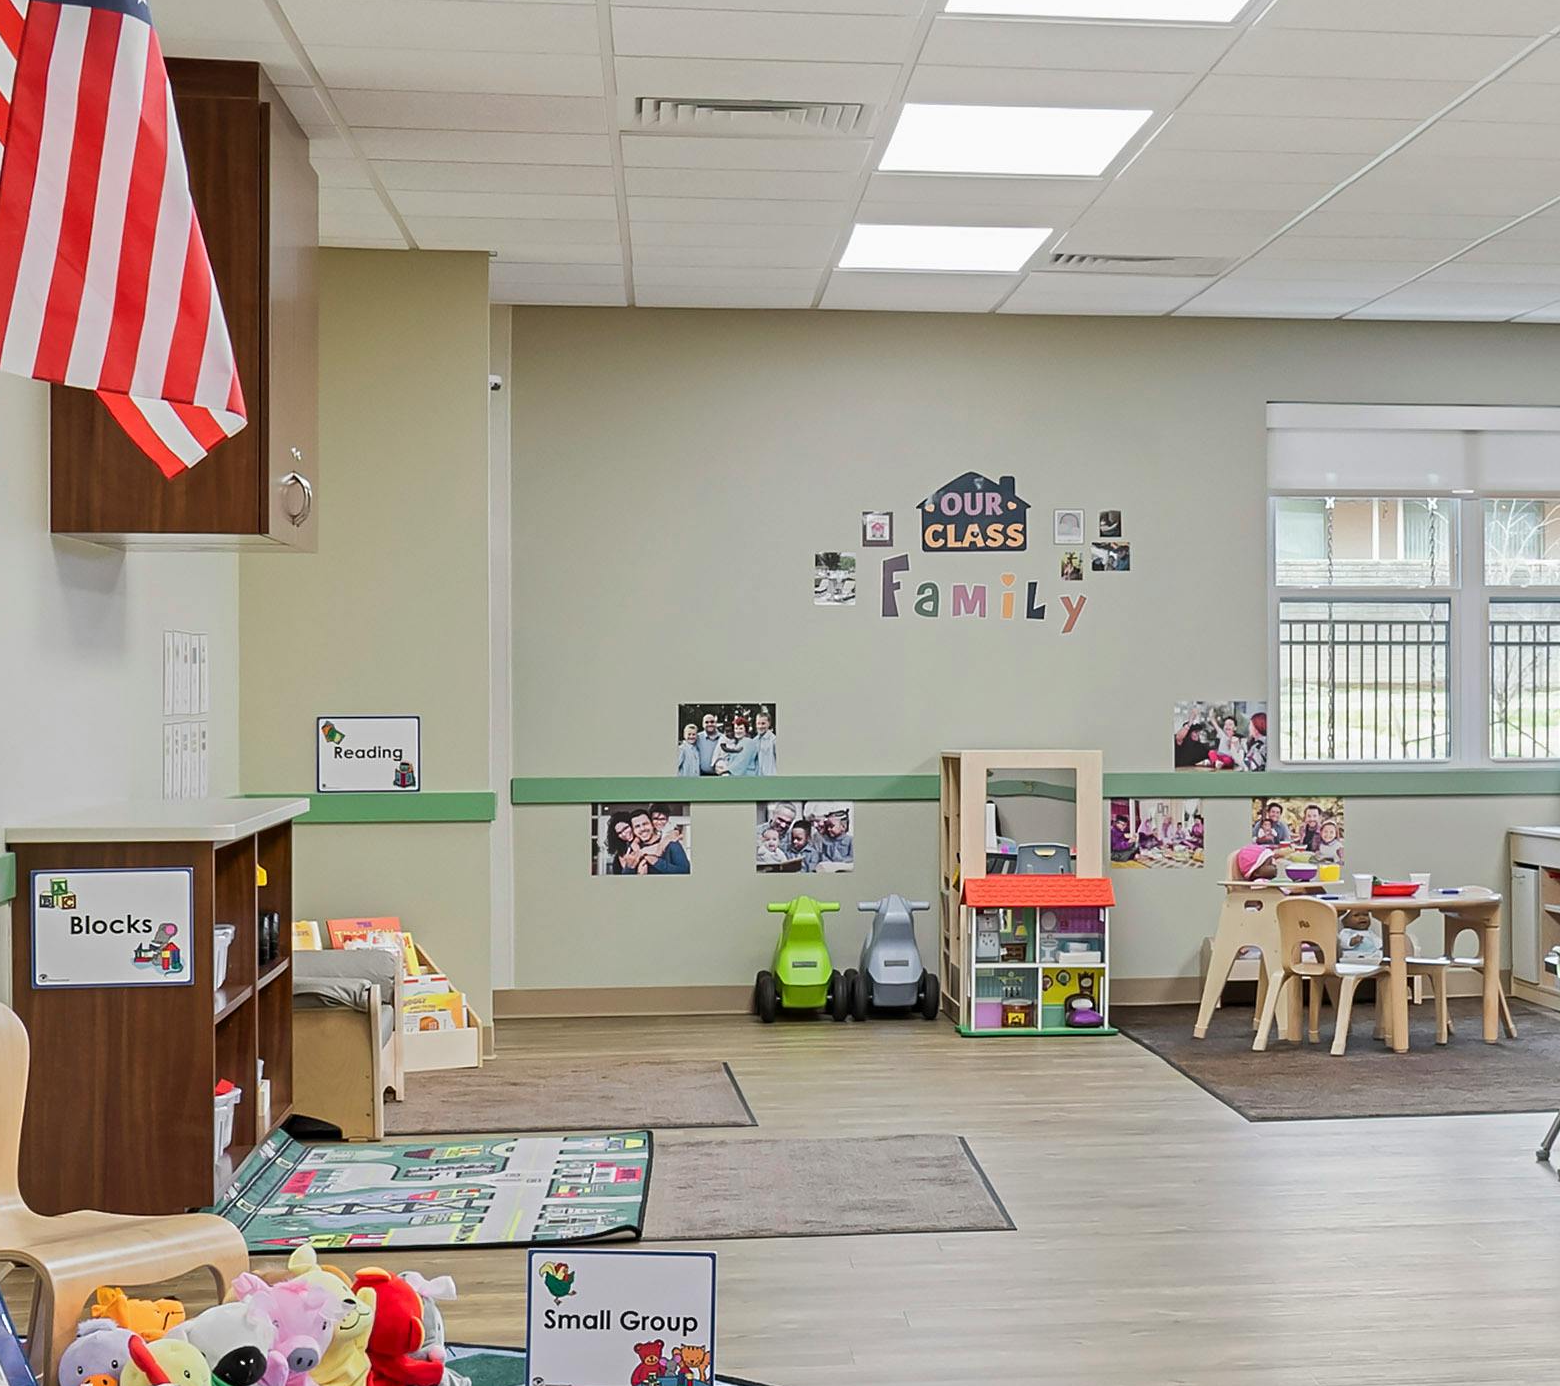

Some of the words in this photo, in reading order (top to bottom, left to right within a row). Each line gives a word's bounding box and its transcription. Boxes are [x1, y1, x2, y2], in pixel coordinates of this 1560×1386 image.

[940, 491, 1004, 517] OUR
[923, 523, 1026, 549] CLASS
[334, 746, 403, 762] Reading
[70, 915, 152, 935] Blocks
[544, 1309, 611, 1330] Small
[620, 1310, 698, 1337] Group
